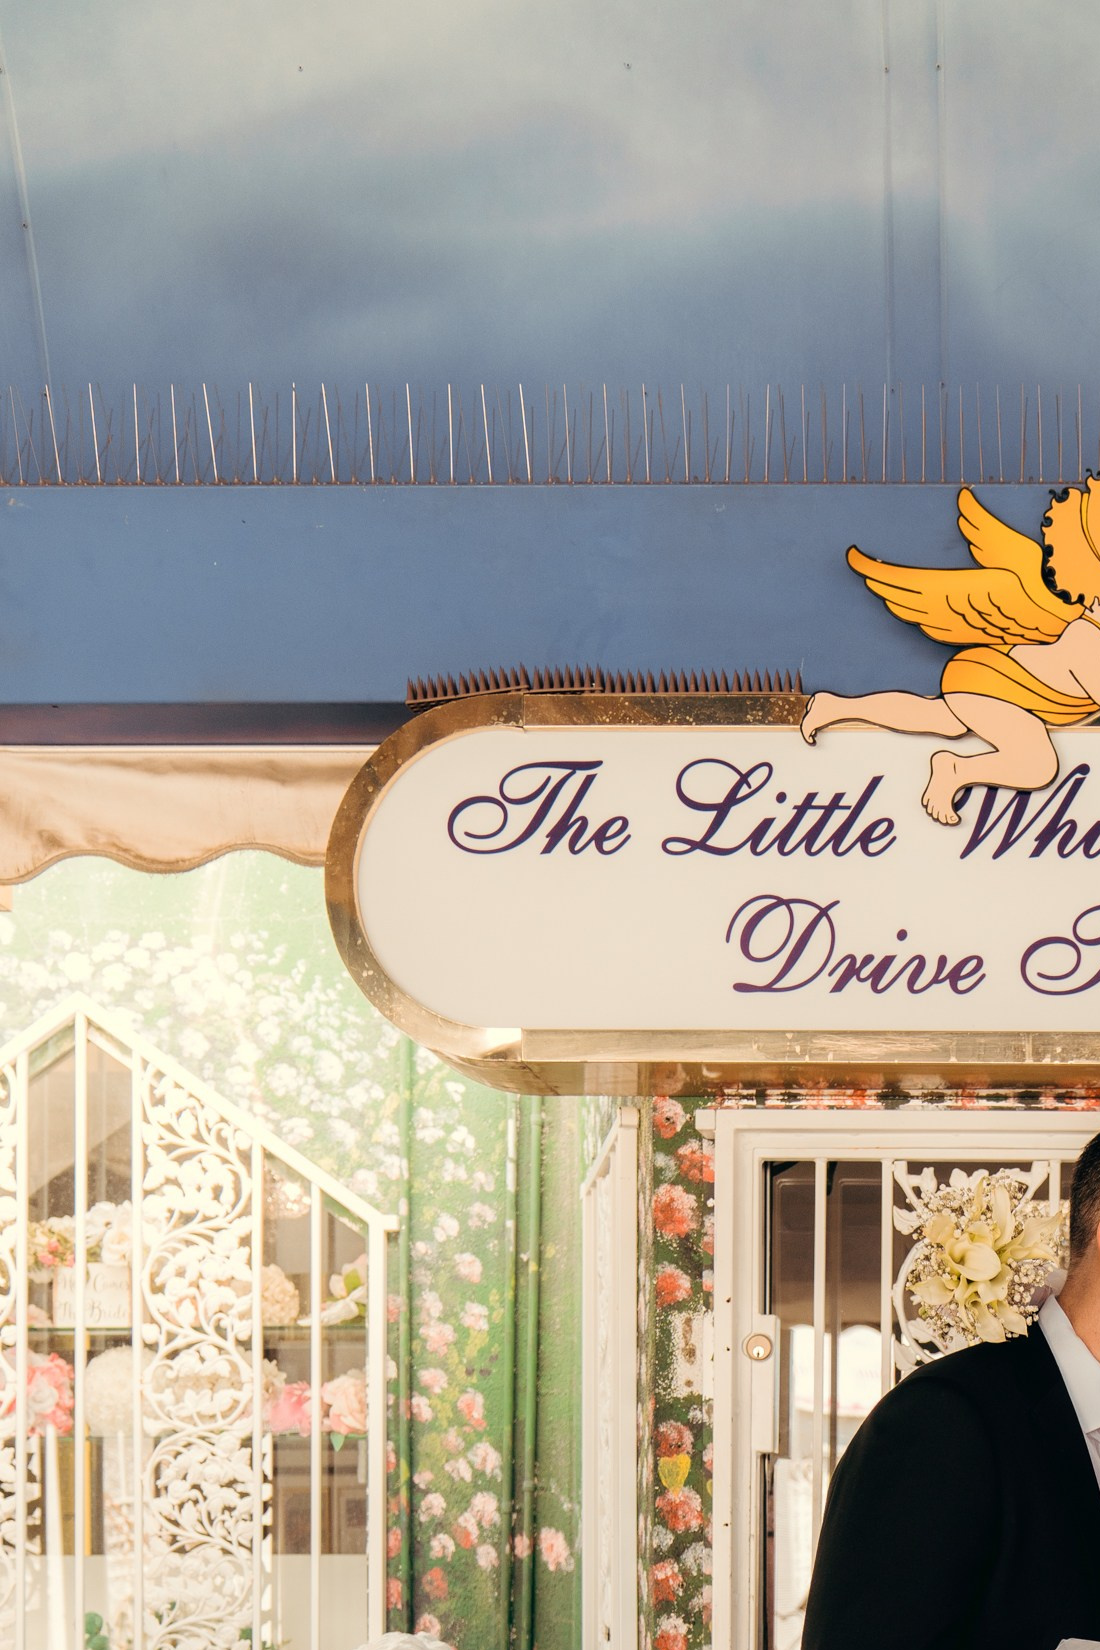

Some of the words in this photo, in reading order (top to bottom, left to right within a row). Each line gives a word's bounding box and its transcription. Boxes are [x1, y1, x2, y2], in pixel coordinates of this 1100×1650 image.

[447, 760, 632, 856] The
[661, 758, 897, 858] Little
[725, 894, 986, 995] Drive
